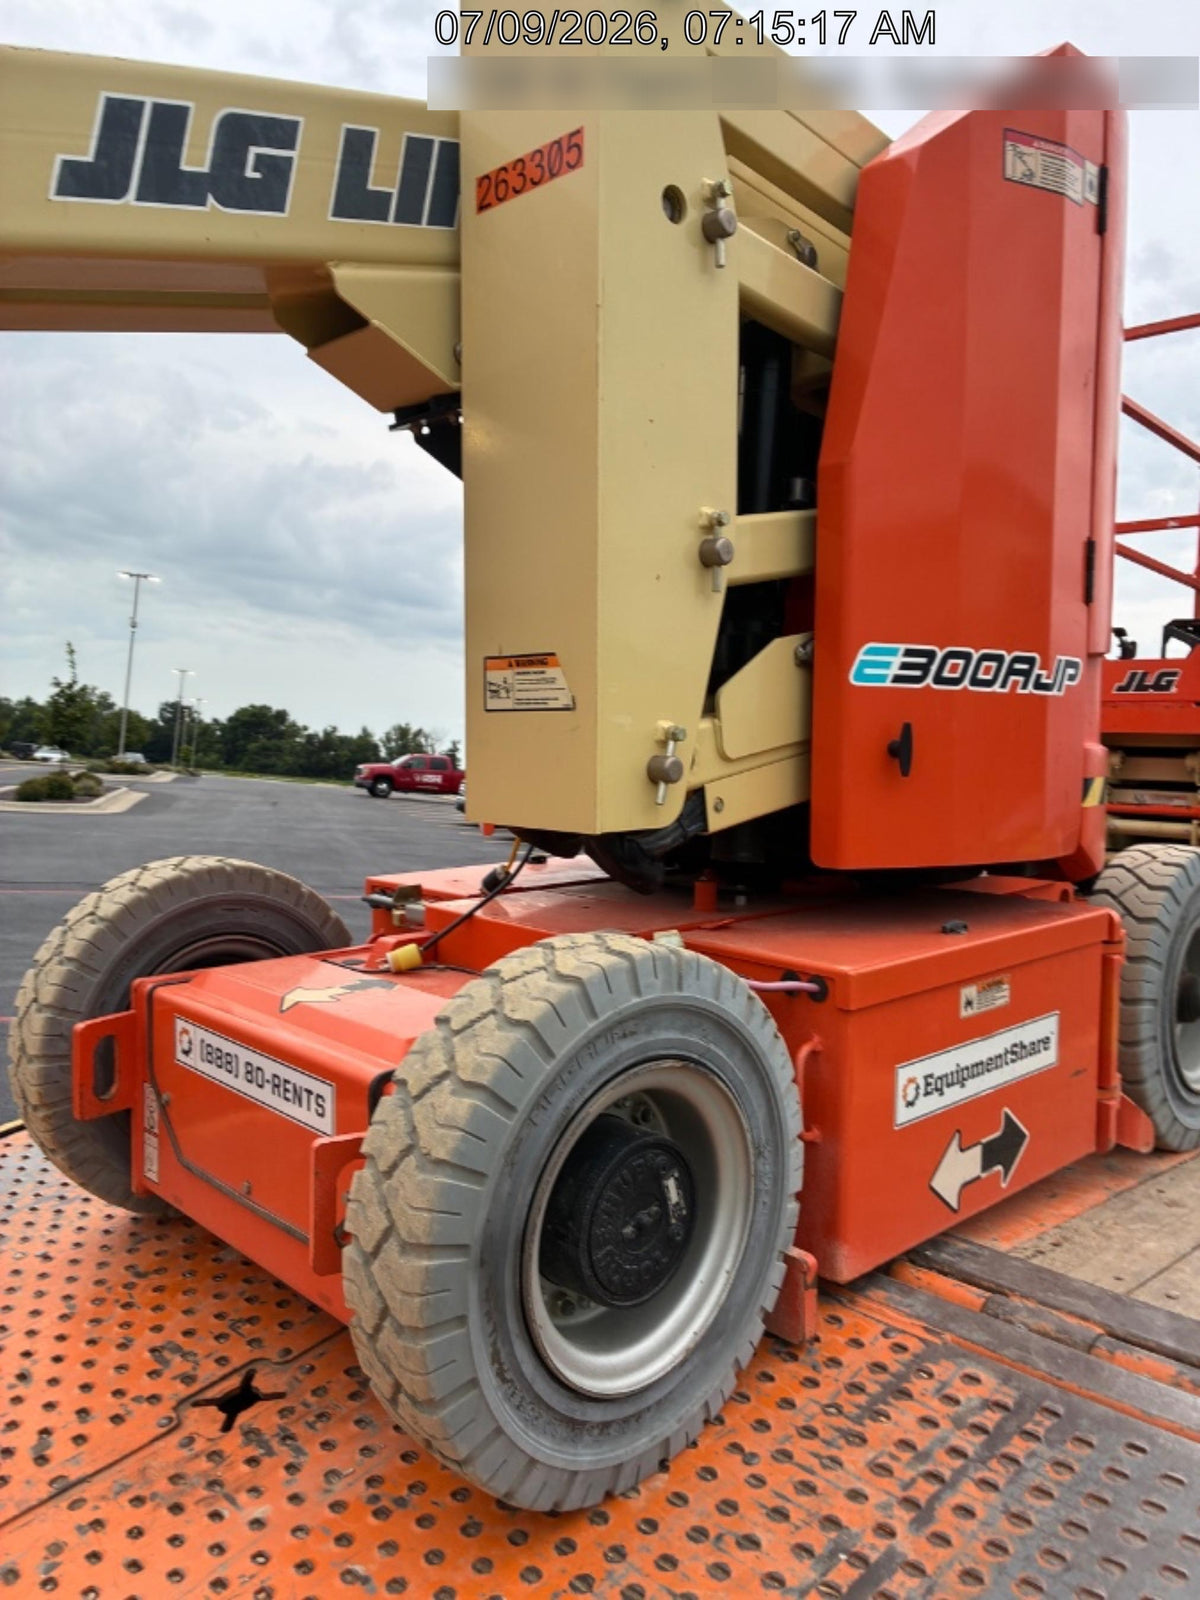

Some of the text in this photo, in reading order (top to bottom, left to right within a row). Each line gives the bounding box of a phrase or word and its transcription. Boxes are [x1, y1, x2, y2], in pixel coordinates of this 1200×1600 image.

[49, 91, 304, 217] JLG
[478, 128, 582, 212] 263305
[850, 642, 1081, 696] E300AJP
[1112, 668, 1182, 694] JLG
[200, 1038, 326, 1118] (888) 80-RENTS
[922, 1035, 1051, 1097] EquipmentShare
